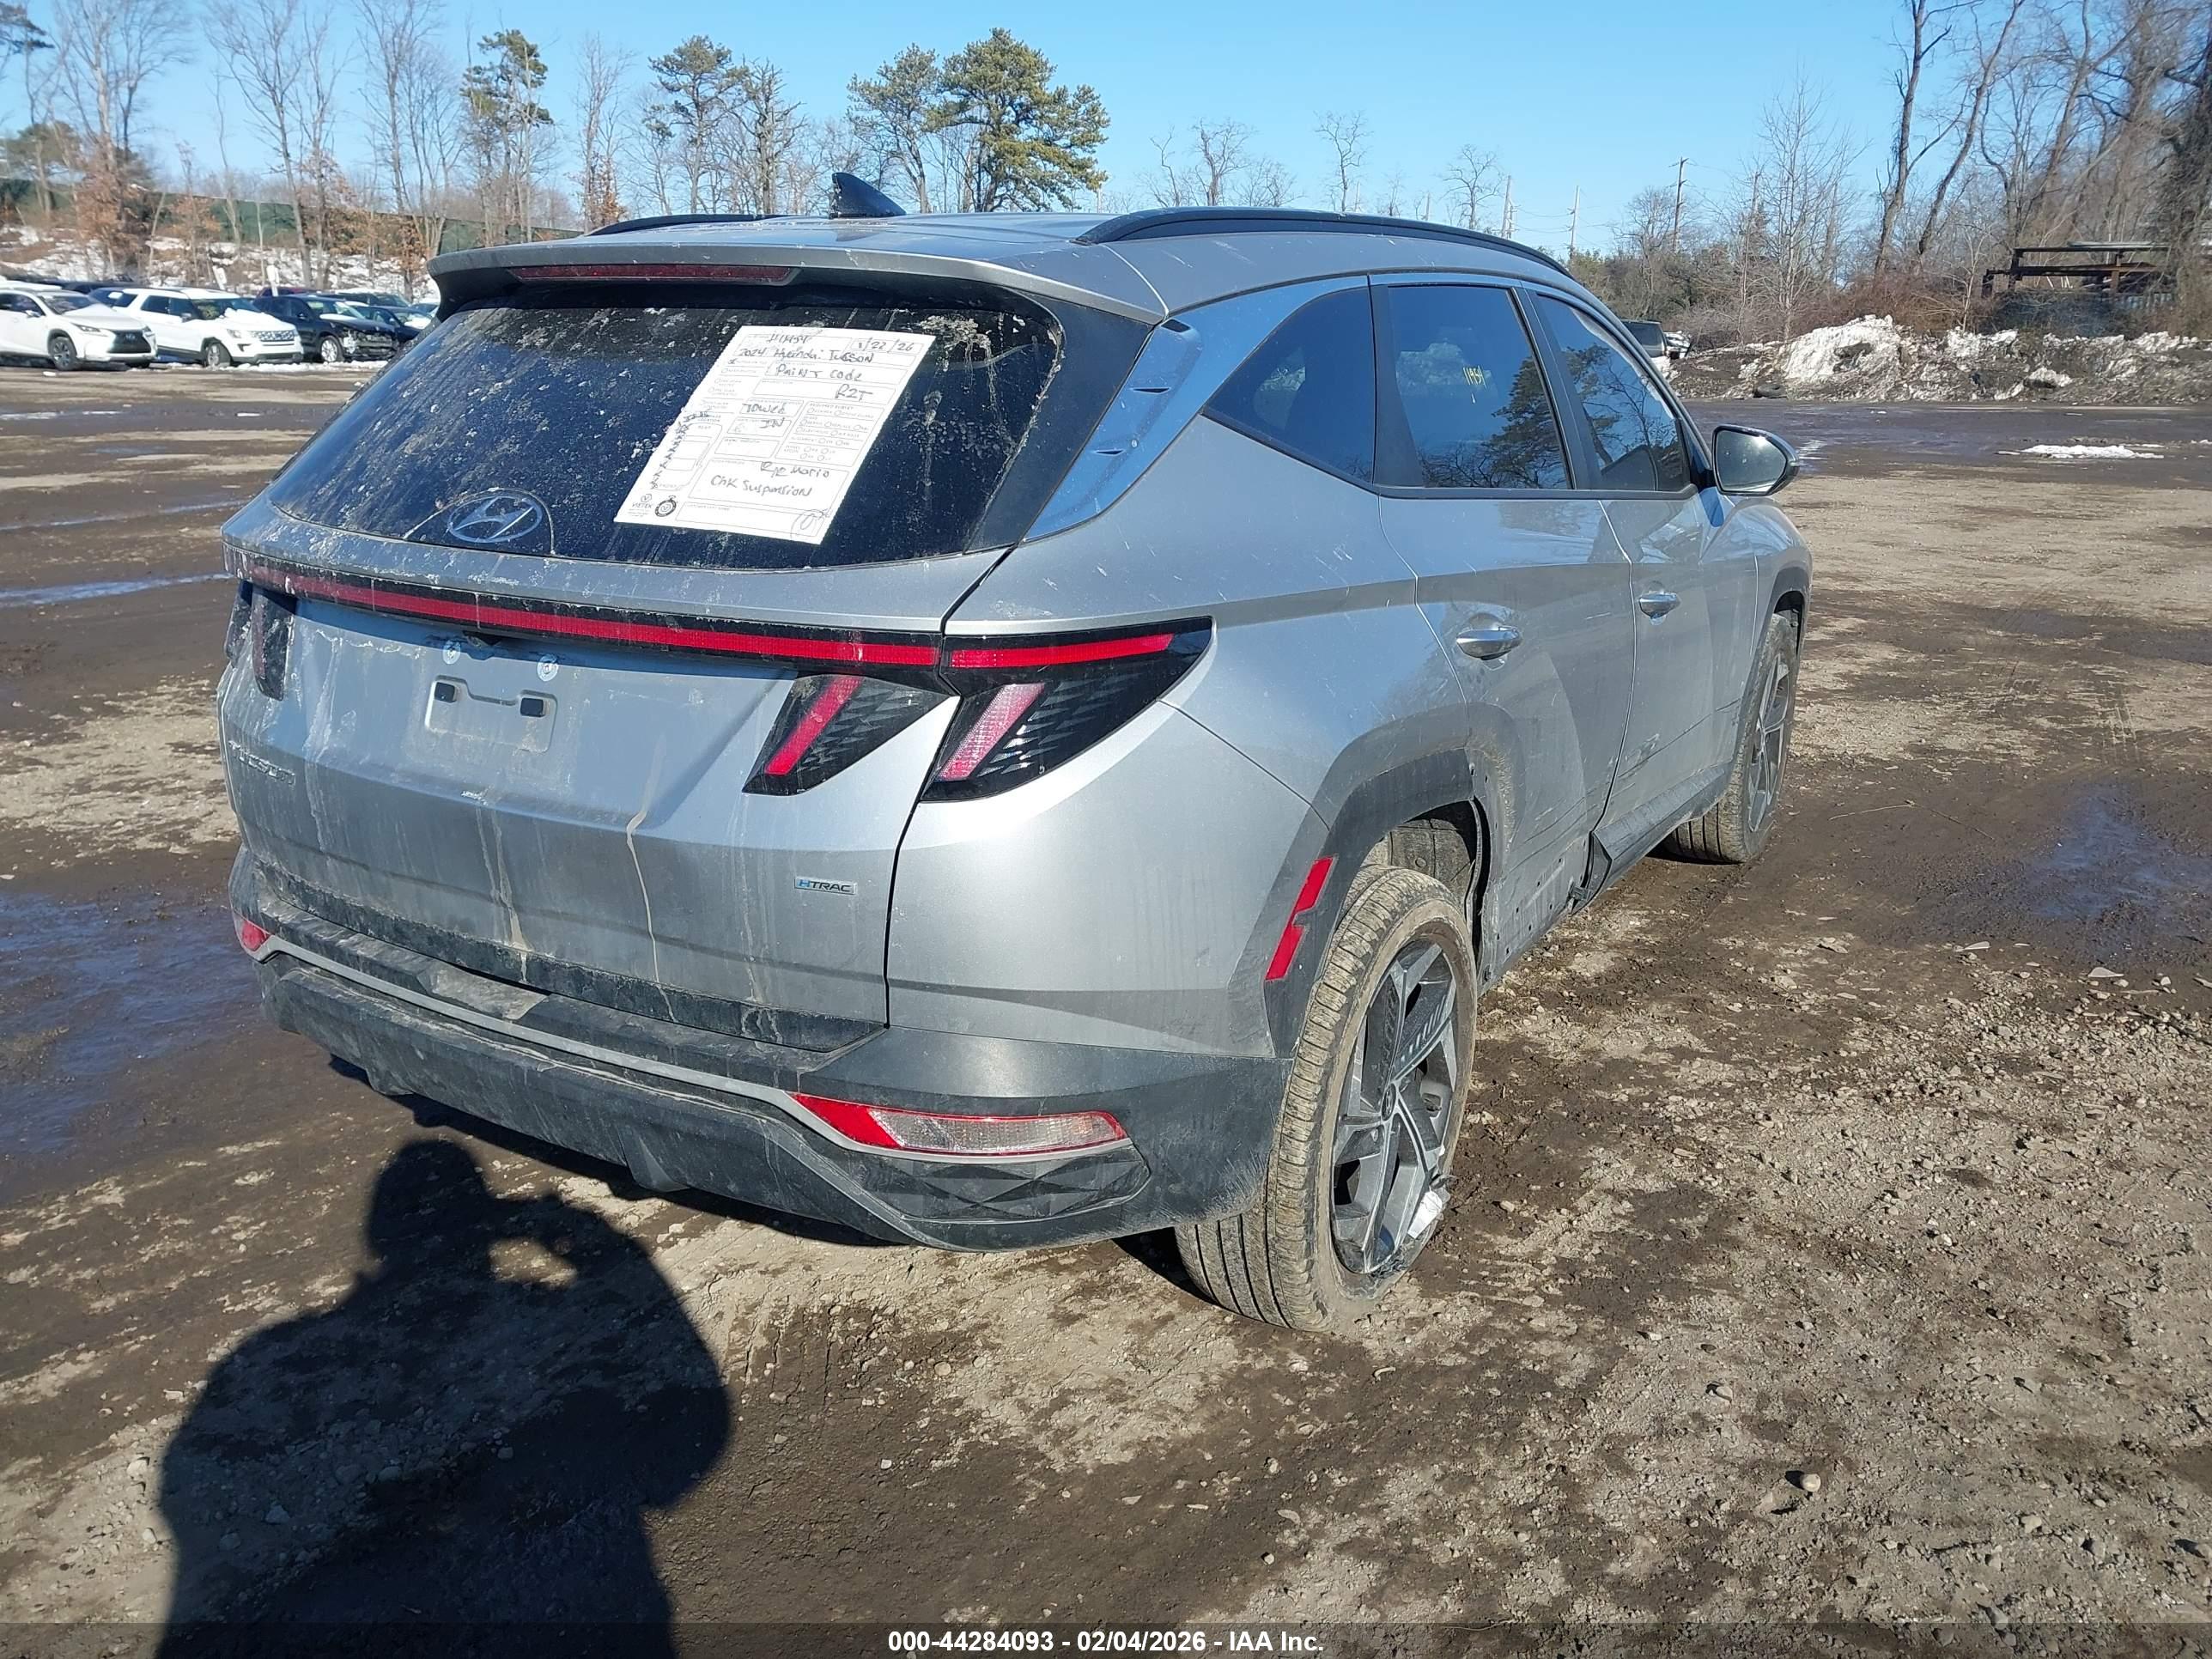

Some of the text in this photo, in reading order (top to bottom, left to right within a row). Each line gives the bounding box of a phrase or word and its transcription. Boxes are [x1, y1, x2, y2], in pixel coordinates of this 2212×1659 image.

[738, 347, 768, 357] 2024
[228, 739, 297, 788] TUCSON
[799, 878, 852, 893] HTRAC
